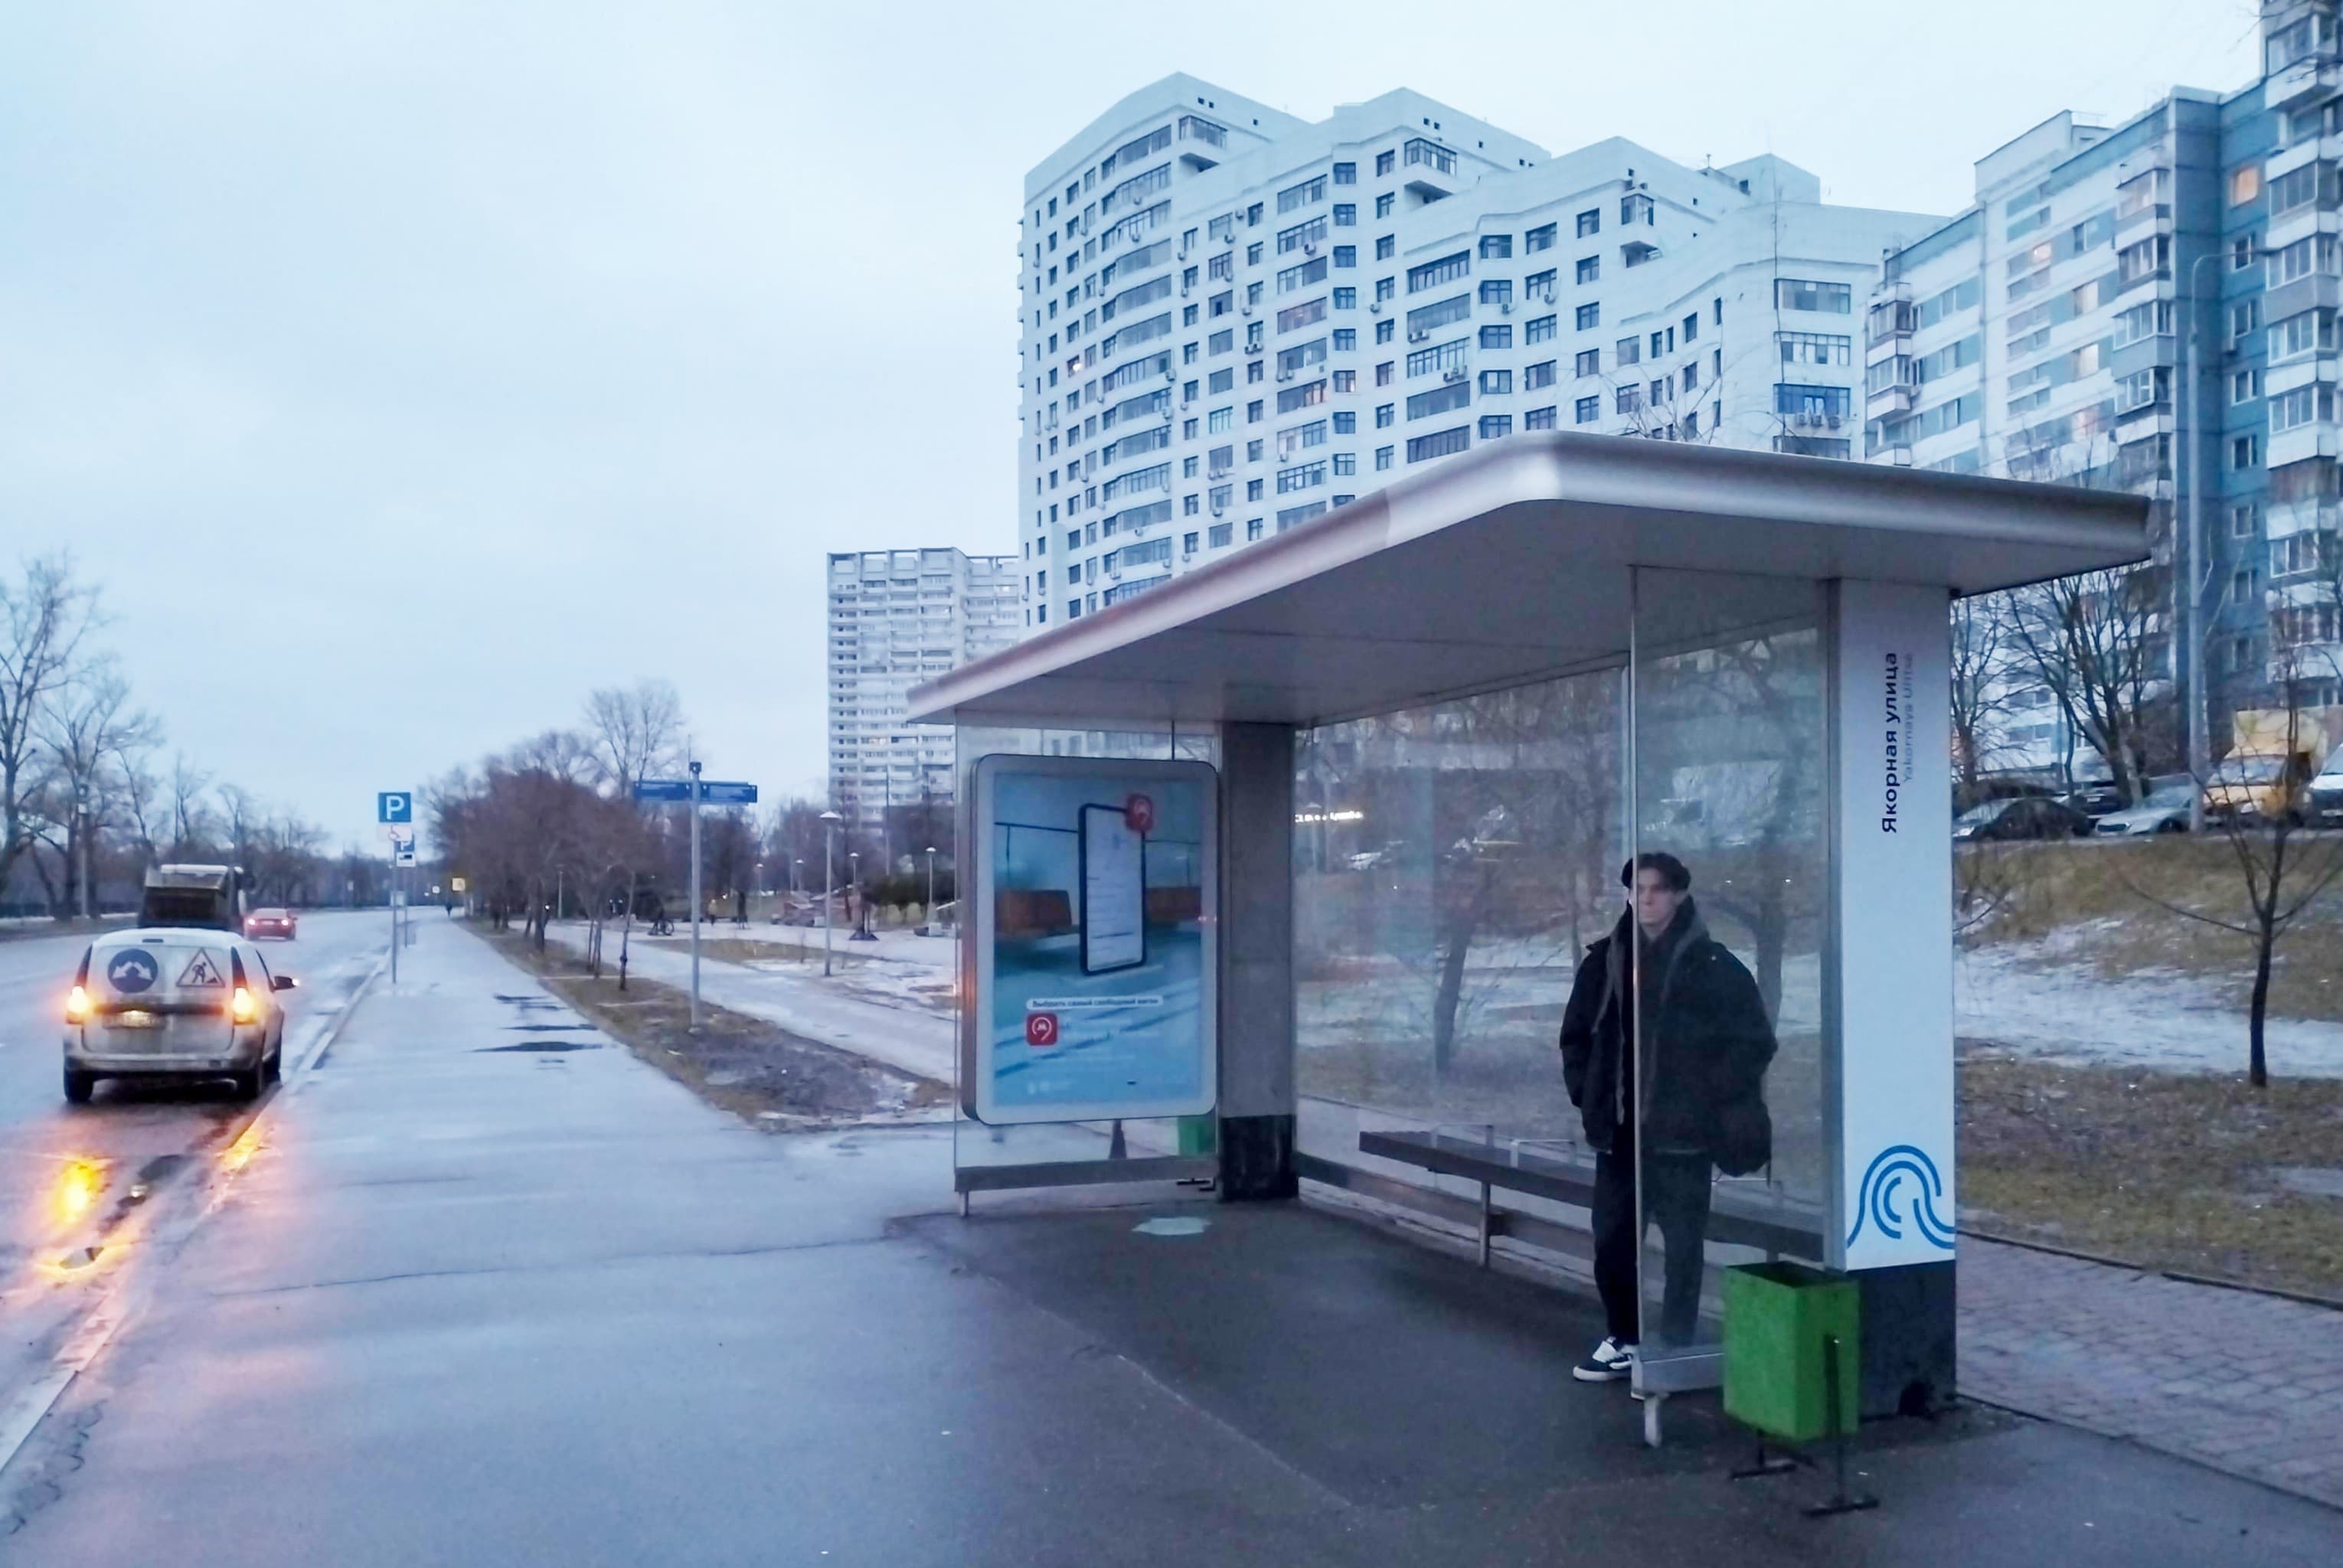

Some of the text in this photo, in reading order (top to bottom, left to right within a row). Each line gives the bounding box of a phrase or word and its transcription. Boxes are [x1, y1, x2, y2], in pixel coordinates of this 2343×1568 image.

[1882, 652, 1900, 833] Якорная улица
[386, 795, 404, 820] P
